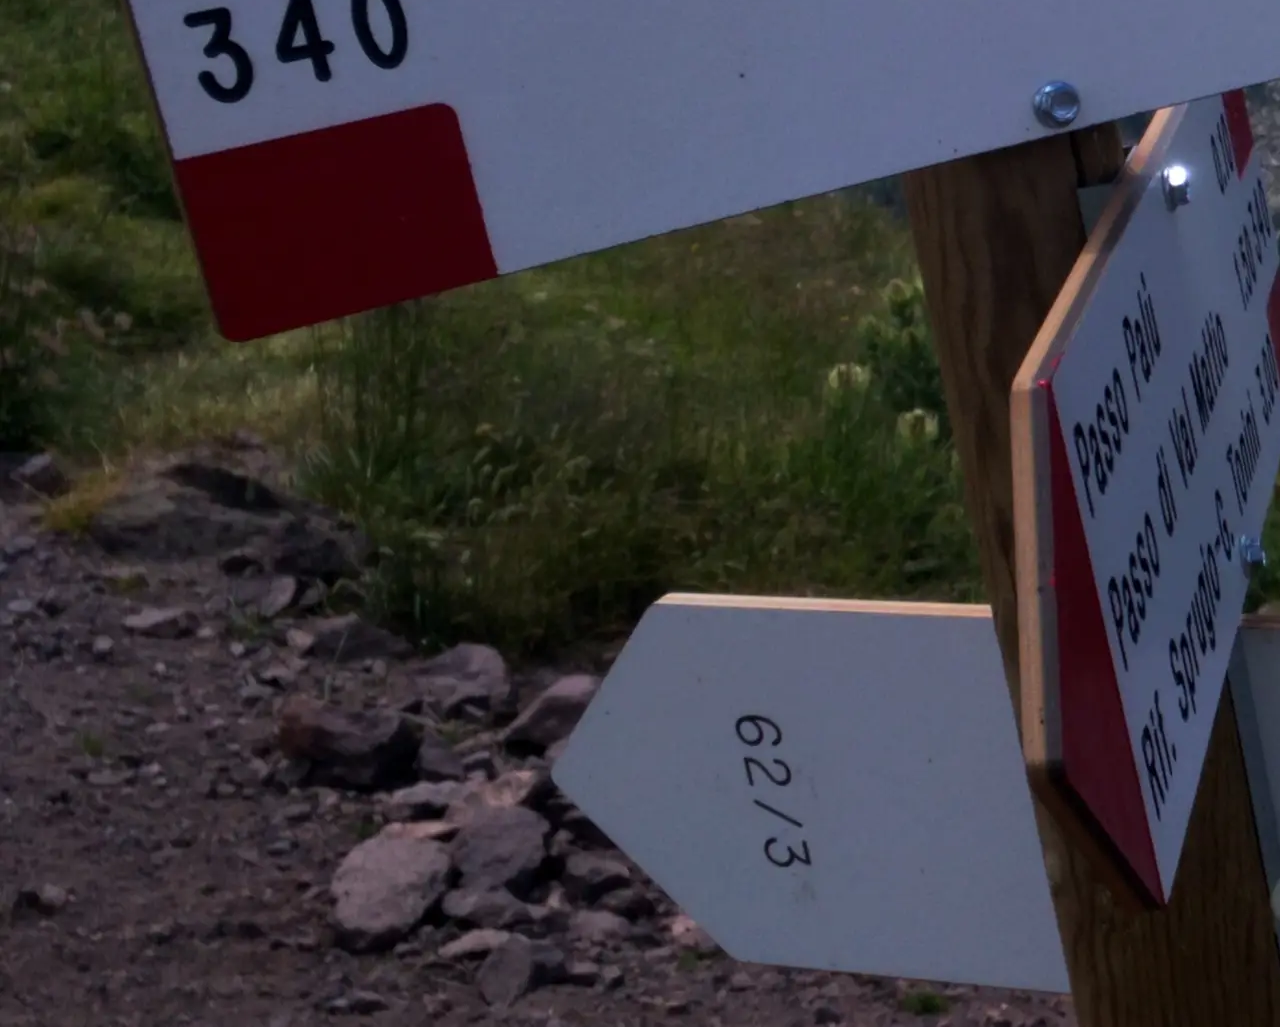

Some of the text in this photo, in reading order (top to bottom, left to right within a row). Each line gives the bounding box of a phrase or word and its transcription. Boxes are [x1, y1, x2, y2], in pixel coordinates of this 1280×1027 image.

[1247, 176, 1272, 265] 340
[1073, 366, 1130, 520] Passo
[1107, 510, 1161, 673] Passo
[1155, 443, 1178, 538] di
[1167, 385, 1199, 490] Val
[1188, 310, 1229, 436] Mattio
[1140, 688, 1177, 823] Rif.
[1225, 388, 1262, 517] Tonini
[1255, 332, 1280, 426] 3.00
[734, 713, 812, 869] 62/3
